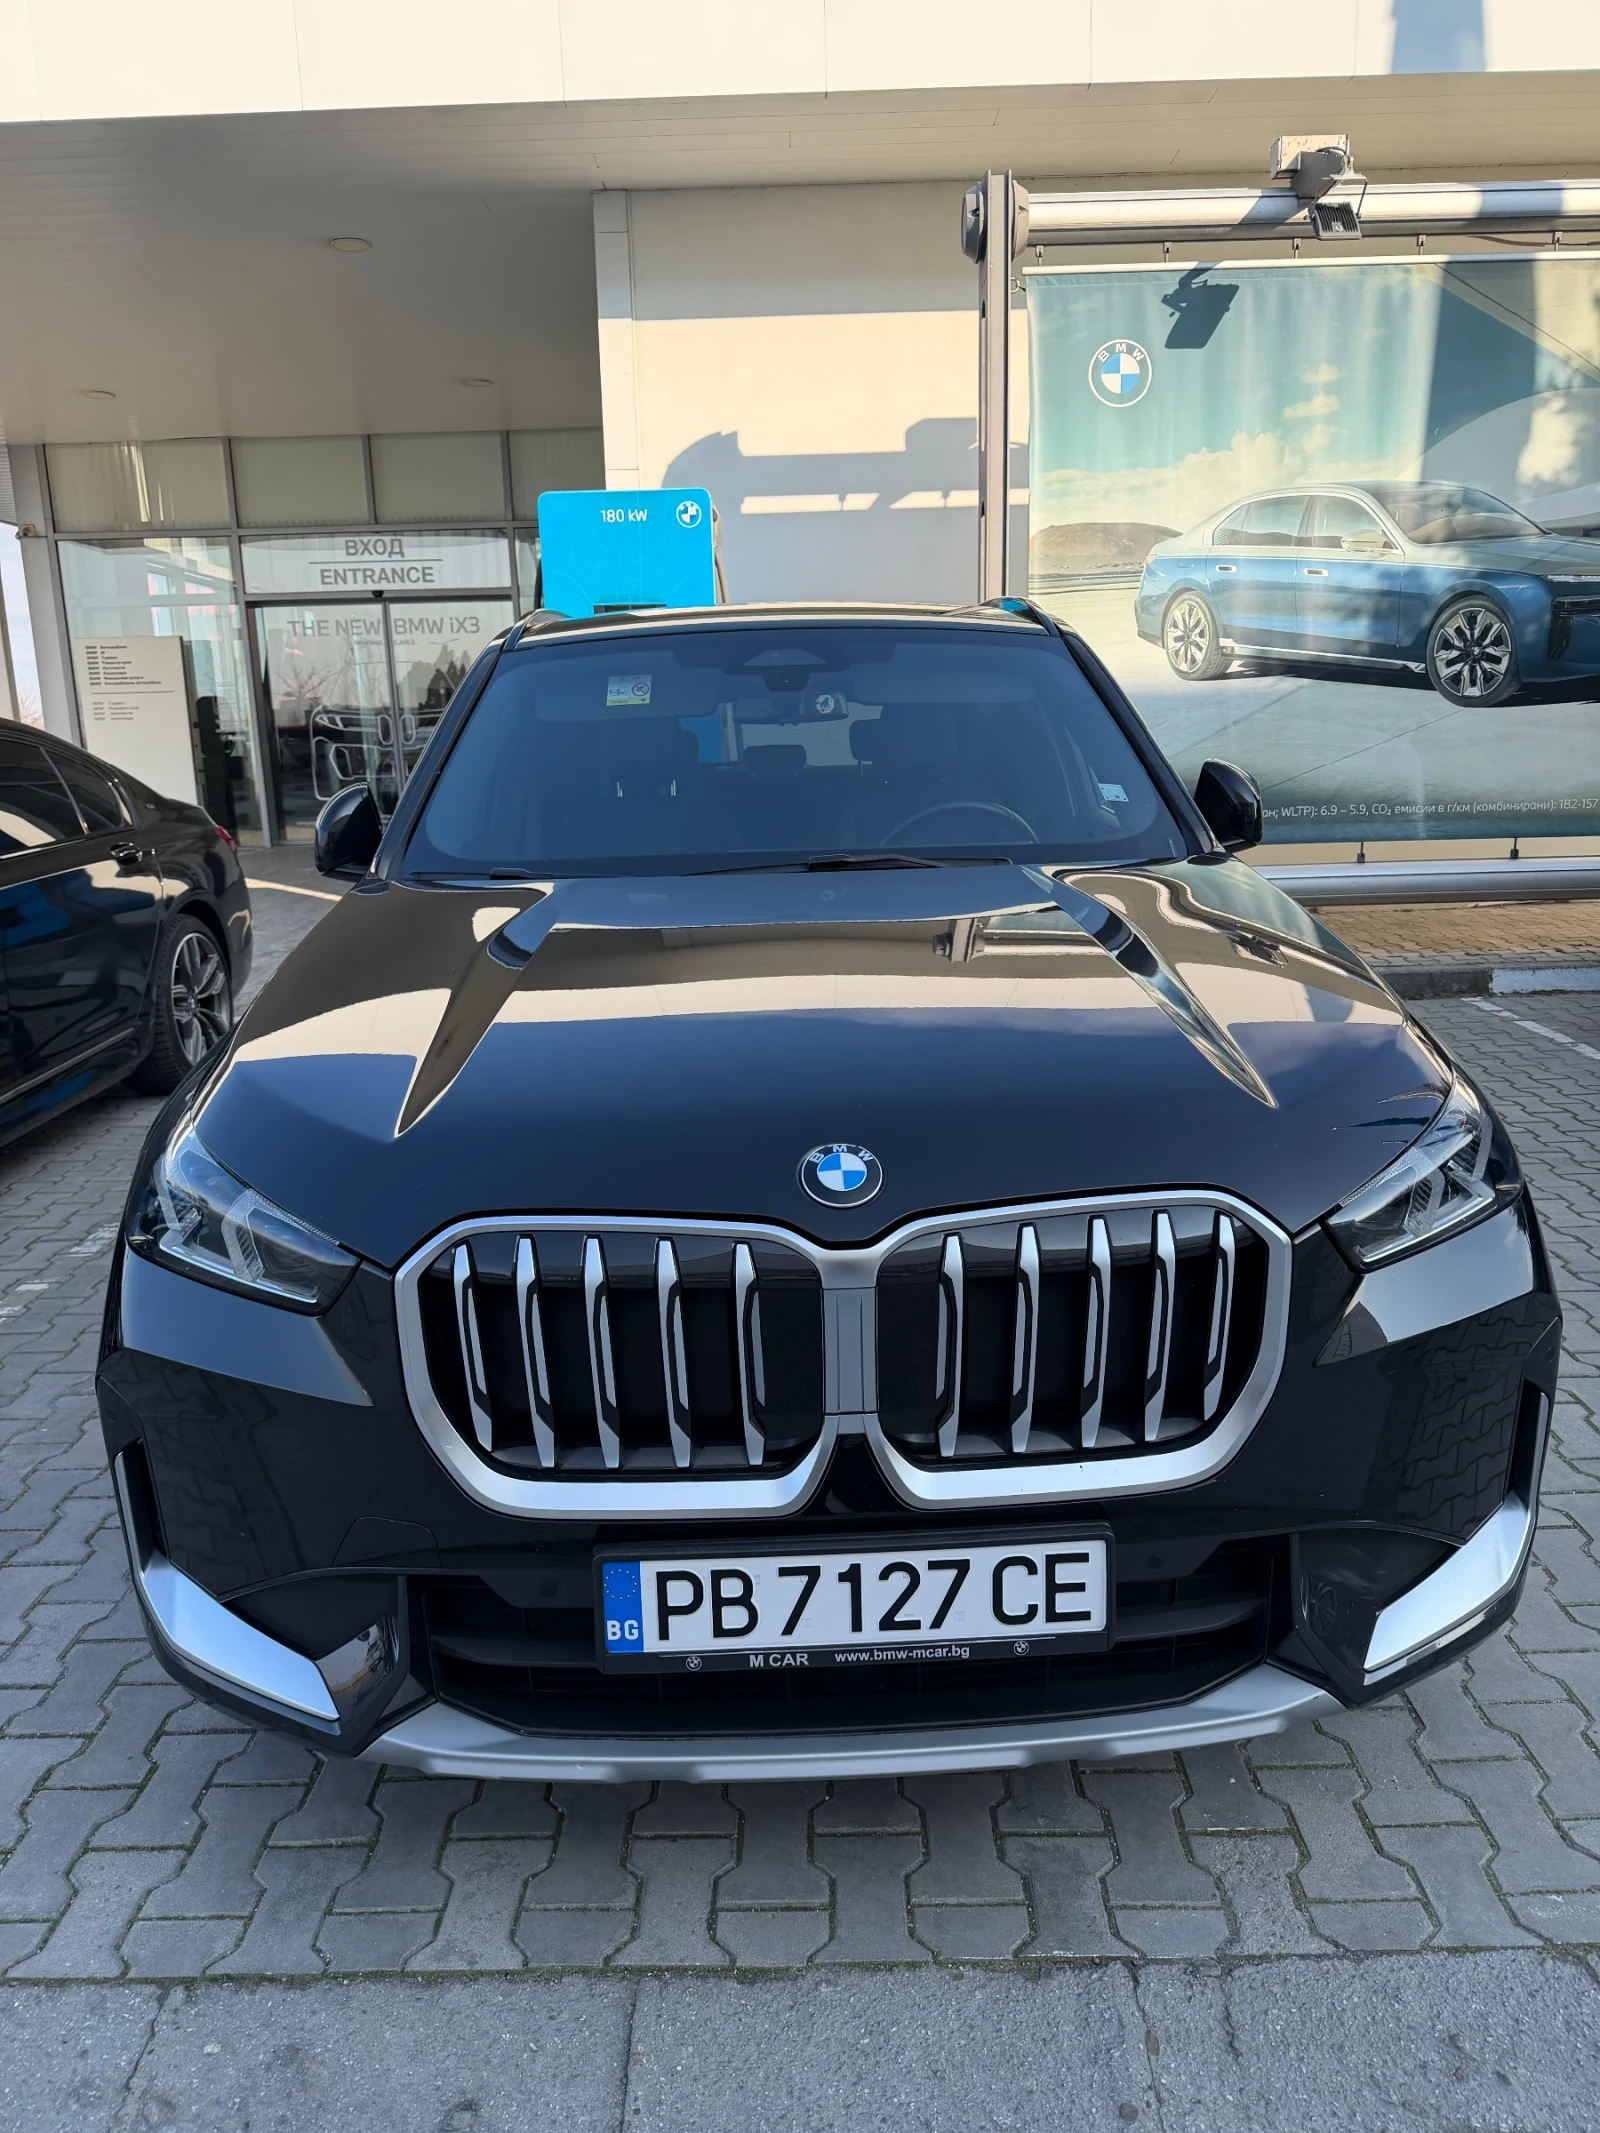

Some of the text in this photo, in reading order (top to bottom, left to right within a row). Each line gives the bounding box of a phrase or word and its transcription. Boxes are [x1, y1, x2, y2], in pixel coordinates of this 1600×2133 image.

[1098, 343, 1145, 363] BMW
[600, 508, 648, 523] 180 kW
[344, 538, 405, 558] ВХОД
[320, 566, 435, 585] ENTRANCE
[287, 615, 481, 637] THE NEW BMW iX3
[1262, 808, 1278, 819] ан;
[1281, 805, 1318, 818] WLTP):
[1320, 804, 1338, 816] 6.9
[1350, 803, 1369, 816] 5.9,
[1394, 804, 1436, 814] емисии
[1438, 804, 1445, 813] в
[1447, 801, 1470, 813] г/км
[1473, 800, 1557, 814] (комбинирани):
[1559, 798, 1599, 810] 182-157
[808, 1144, 874, 1164] BMW
[656, 1552, 1092, 1640] PB 7127 CE
[606, 1619, 639, 1641] BG
[749, 1645, 970, 1668] M CAR www.bmw-mcar.bg
